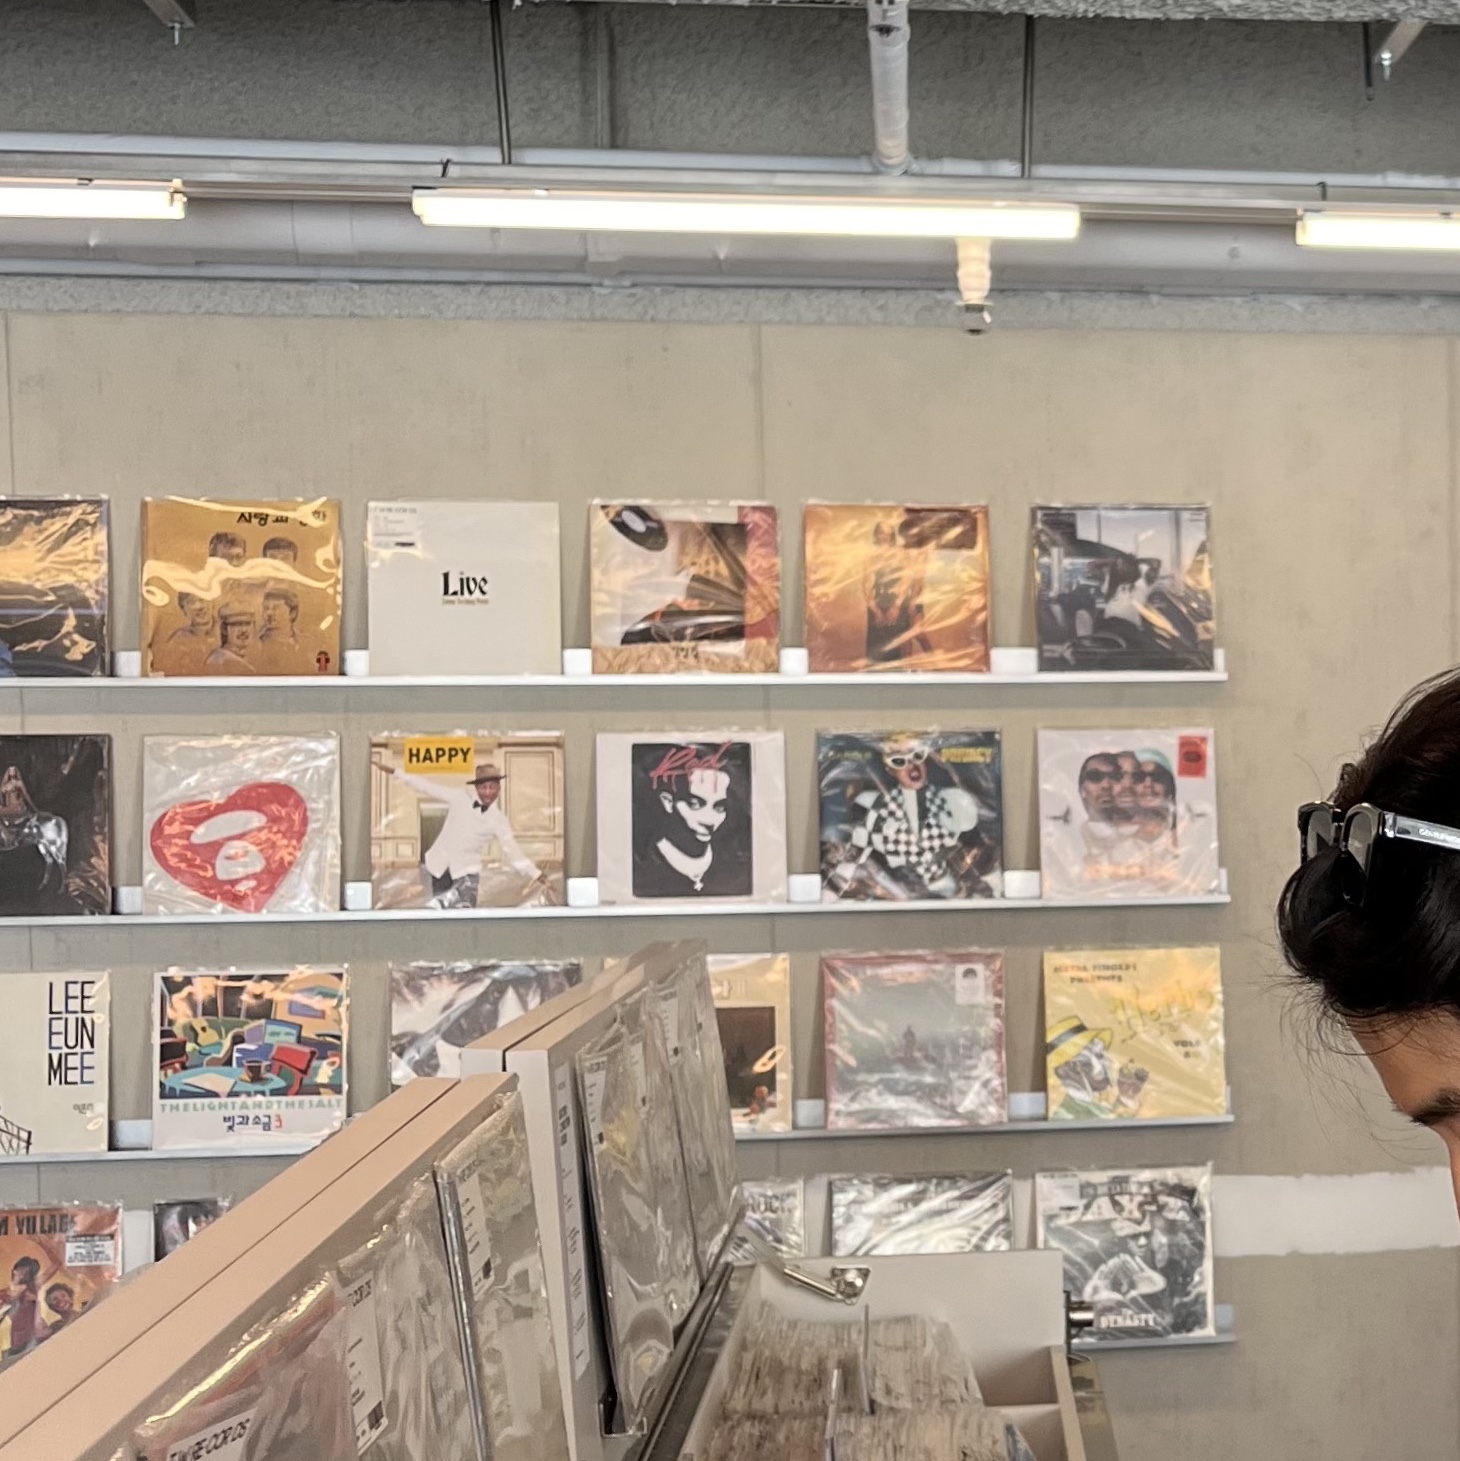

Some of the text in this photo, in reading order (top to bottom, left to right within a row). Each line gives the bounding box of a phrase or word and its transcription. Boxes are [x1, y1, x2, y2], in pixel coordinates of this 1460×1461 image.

[442, 571, 488, 596] Live
[408, 747, 471, 764] HAPPY
[48, 980, 95, 1014] LEE
[48, 1016, 95, 1050] EUN
[48, 1051, 95, 1085] MEE
[222, 1115, 249, 1132] 빛과
[252, 1114, 272, 1132] 소금
